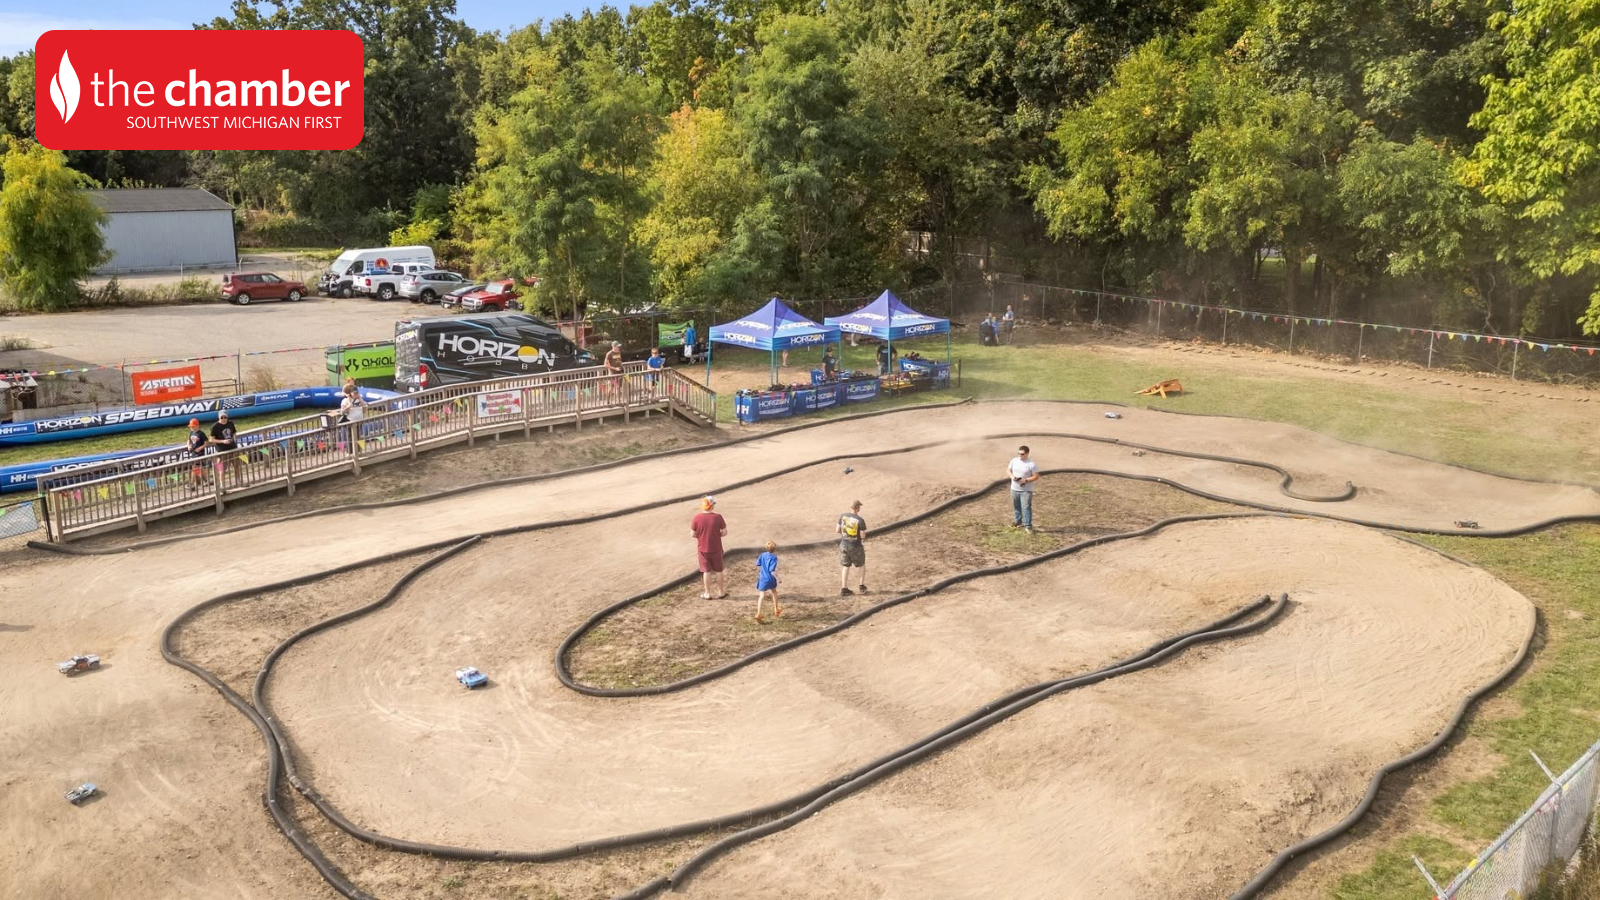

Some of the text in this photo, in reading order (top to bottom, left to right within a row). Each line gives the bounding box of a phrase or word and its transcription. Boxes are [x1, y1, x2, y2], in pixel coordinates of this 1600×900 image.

[839, 322, 872, 334] HORIZON
[905, 324, 936, 334] HORIZON
[724, 332, 756, 344] HORIZON
[790, 333, 825, 344] HORIZON
[438, 333, 556, 367] HORIZON
[846, 384, 876, 394] HORIZON
[758, 398, 790, 408] HORIZON
[36, 416, 102, 429] HORIZON
[104, 400, 216, 425] SPEEDWAY
